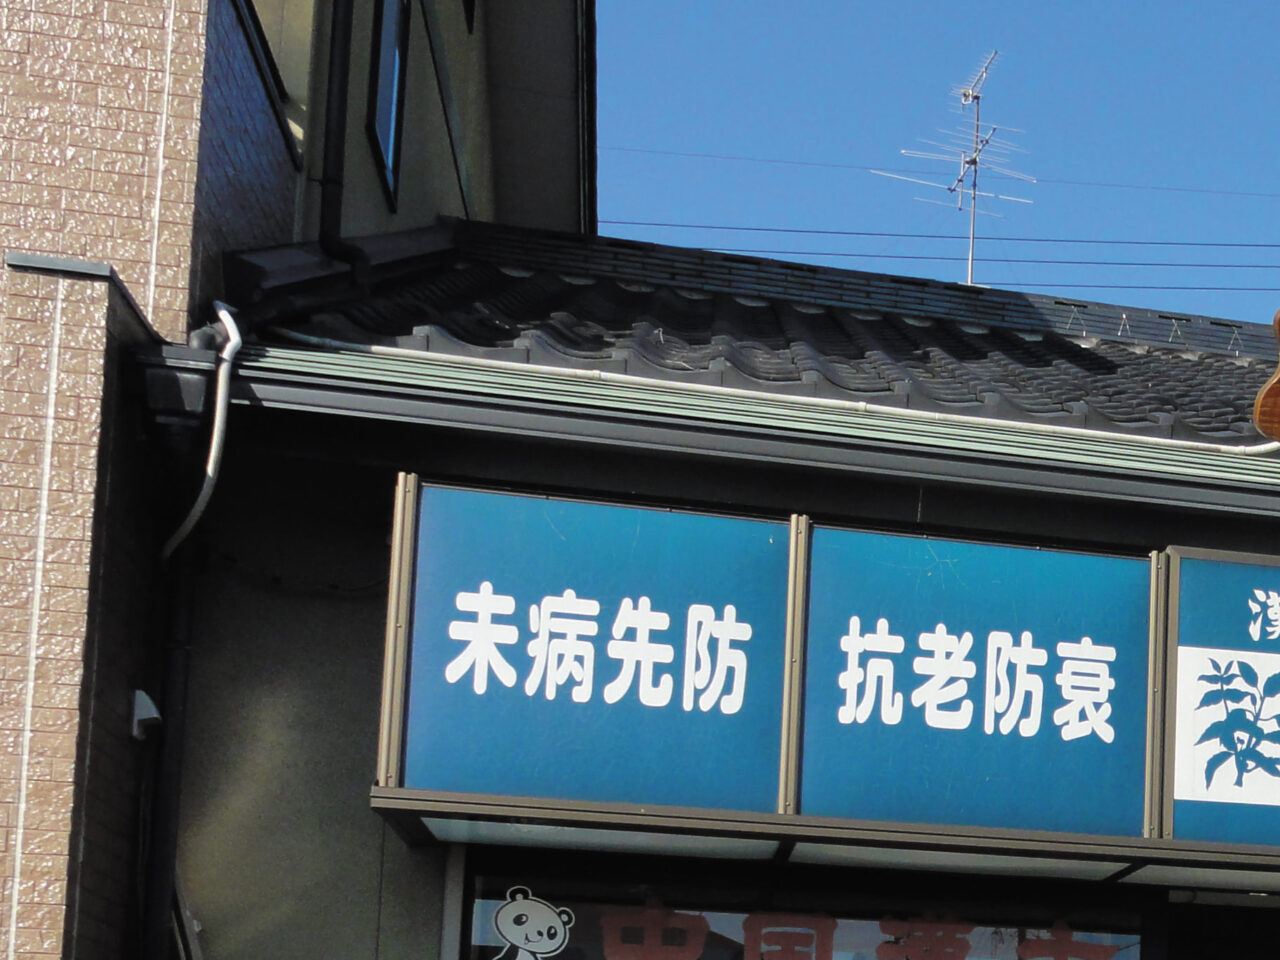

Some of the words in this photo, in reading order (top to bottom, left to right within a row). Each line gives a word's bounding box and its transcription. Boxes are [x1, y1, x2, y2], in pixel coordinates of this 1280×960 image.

[446, 581, 752, 715] 未病先防
[837, 615, 1117, 744] 抗老防衰
